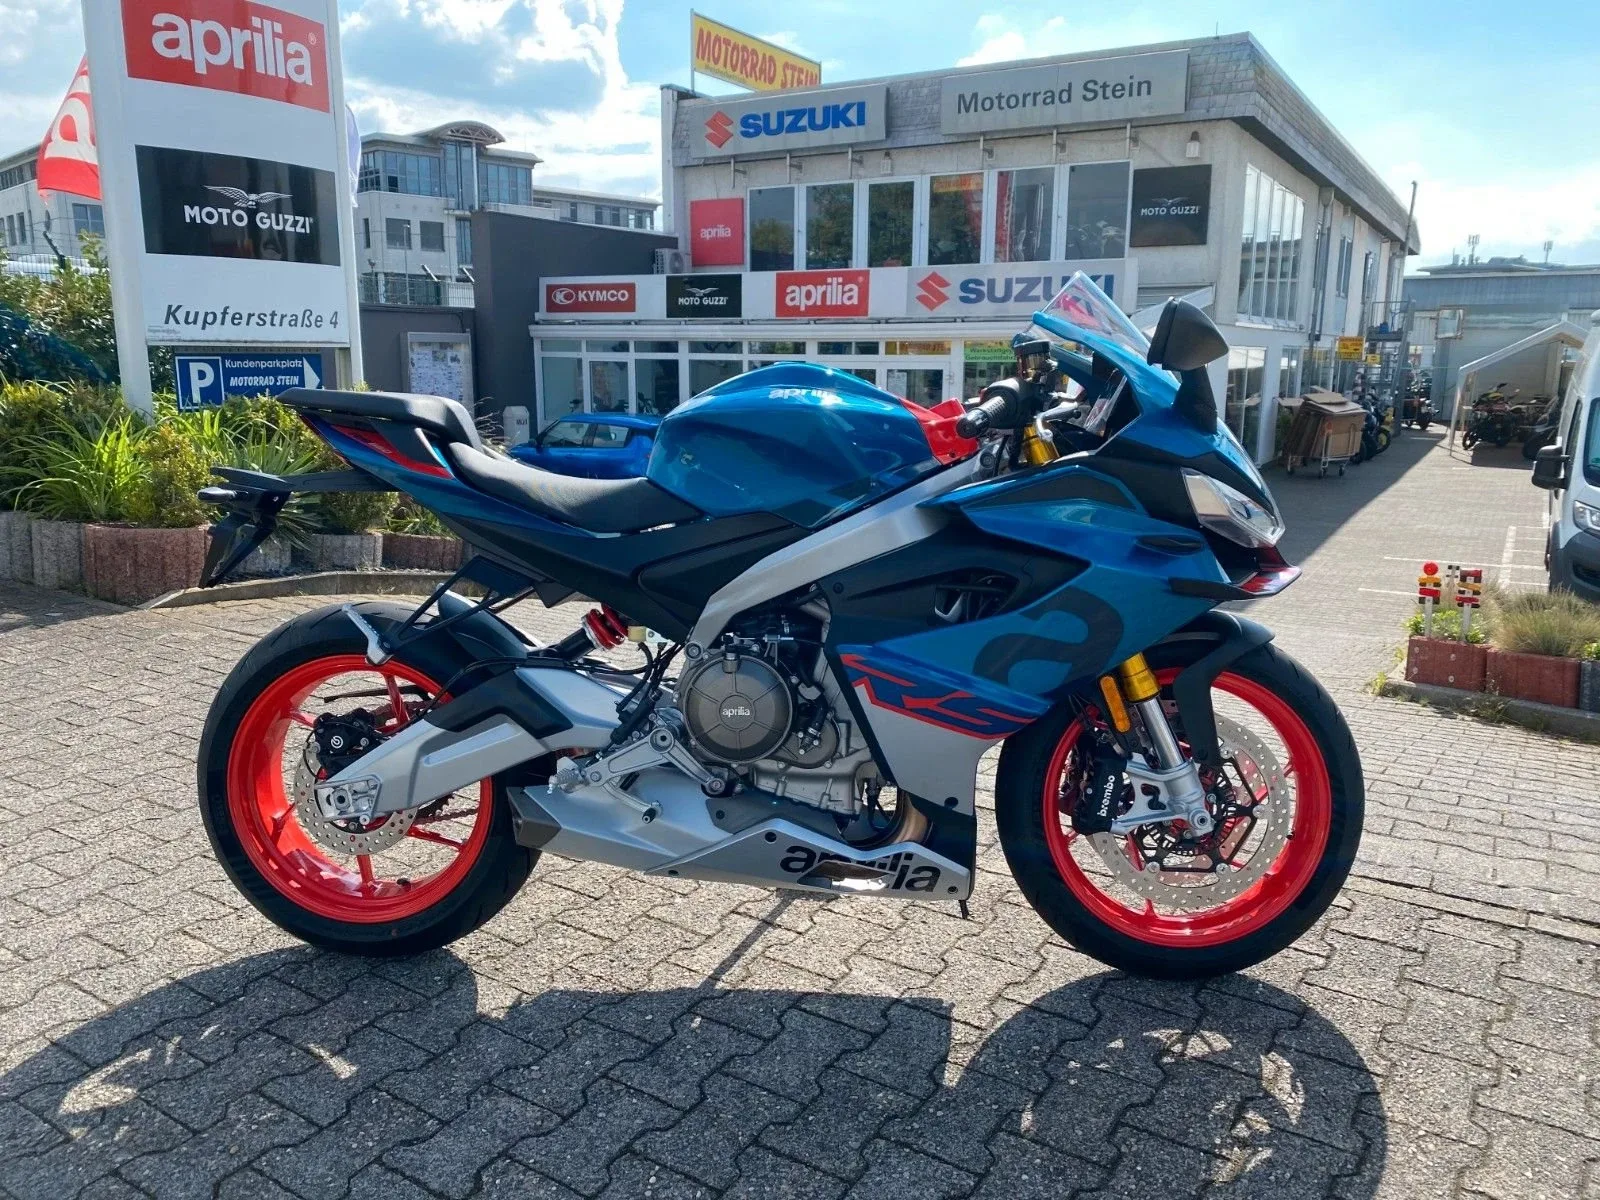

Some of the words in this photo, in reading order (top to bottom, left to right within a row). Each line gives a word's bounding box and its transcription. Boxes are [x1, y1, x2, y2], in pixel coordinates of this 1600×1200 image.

[152, 13, 312, 86] aprilia
[696, 27, 777, 85] MOTORRAD
[781, 61, 818, 89] STEIN
[957, 82, 1072, 114] Motorrad
[1082, 75, 1152, 101] Stein
[739, 101, 866, 138] SUZUKI
[184, 205, 248, 227] MOTO
[255, 211, 310, 234] GUZZI
[1140, 207, 1167, 217] MOTO
[1169, 205, 1199, 215] GUZZI
[700, 224, 732, 240] aprilia
[578, 289, 629, 302] KYMCO
[678, 297, 700, 305] MOTO
[702, 296, 727, 305] GUZZI
[785, 277, 859, 311] aprilia
[164, 304, 324, 331] Kupferstraße
[329, 311, 339, 329] 4
[225, 359, 303, 370] Kundenparkplatz
[189, 361, 215, 403] P
[229, 376, 275, 387] MOTORRAD
[276, 375, 299, 386] STEIN
[722, 706, 751, 717] aprilia
[1097, 775, 1116, 817] brembo
